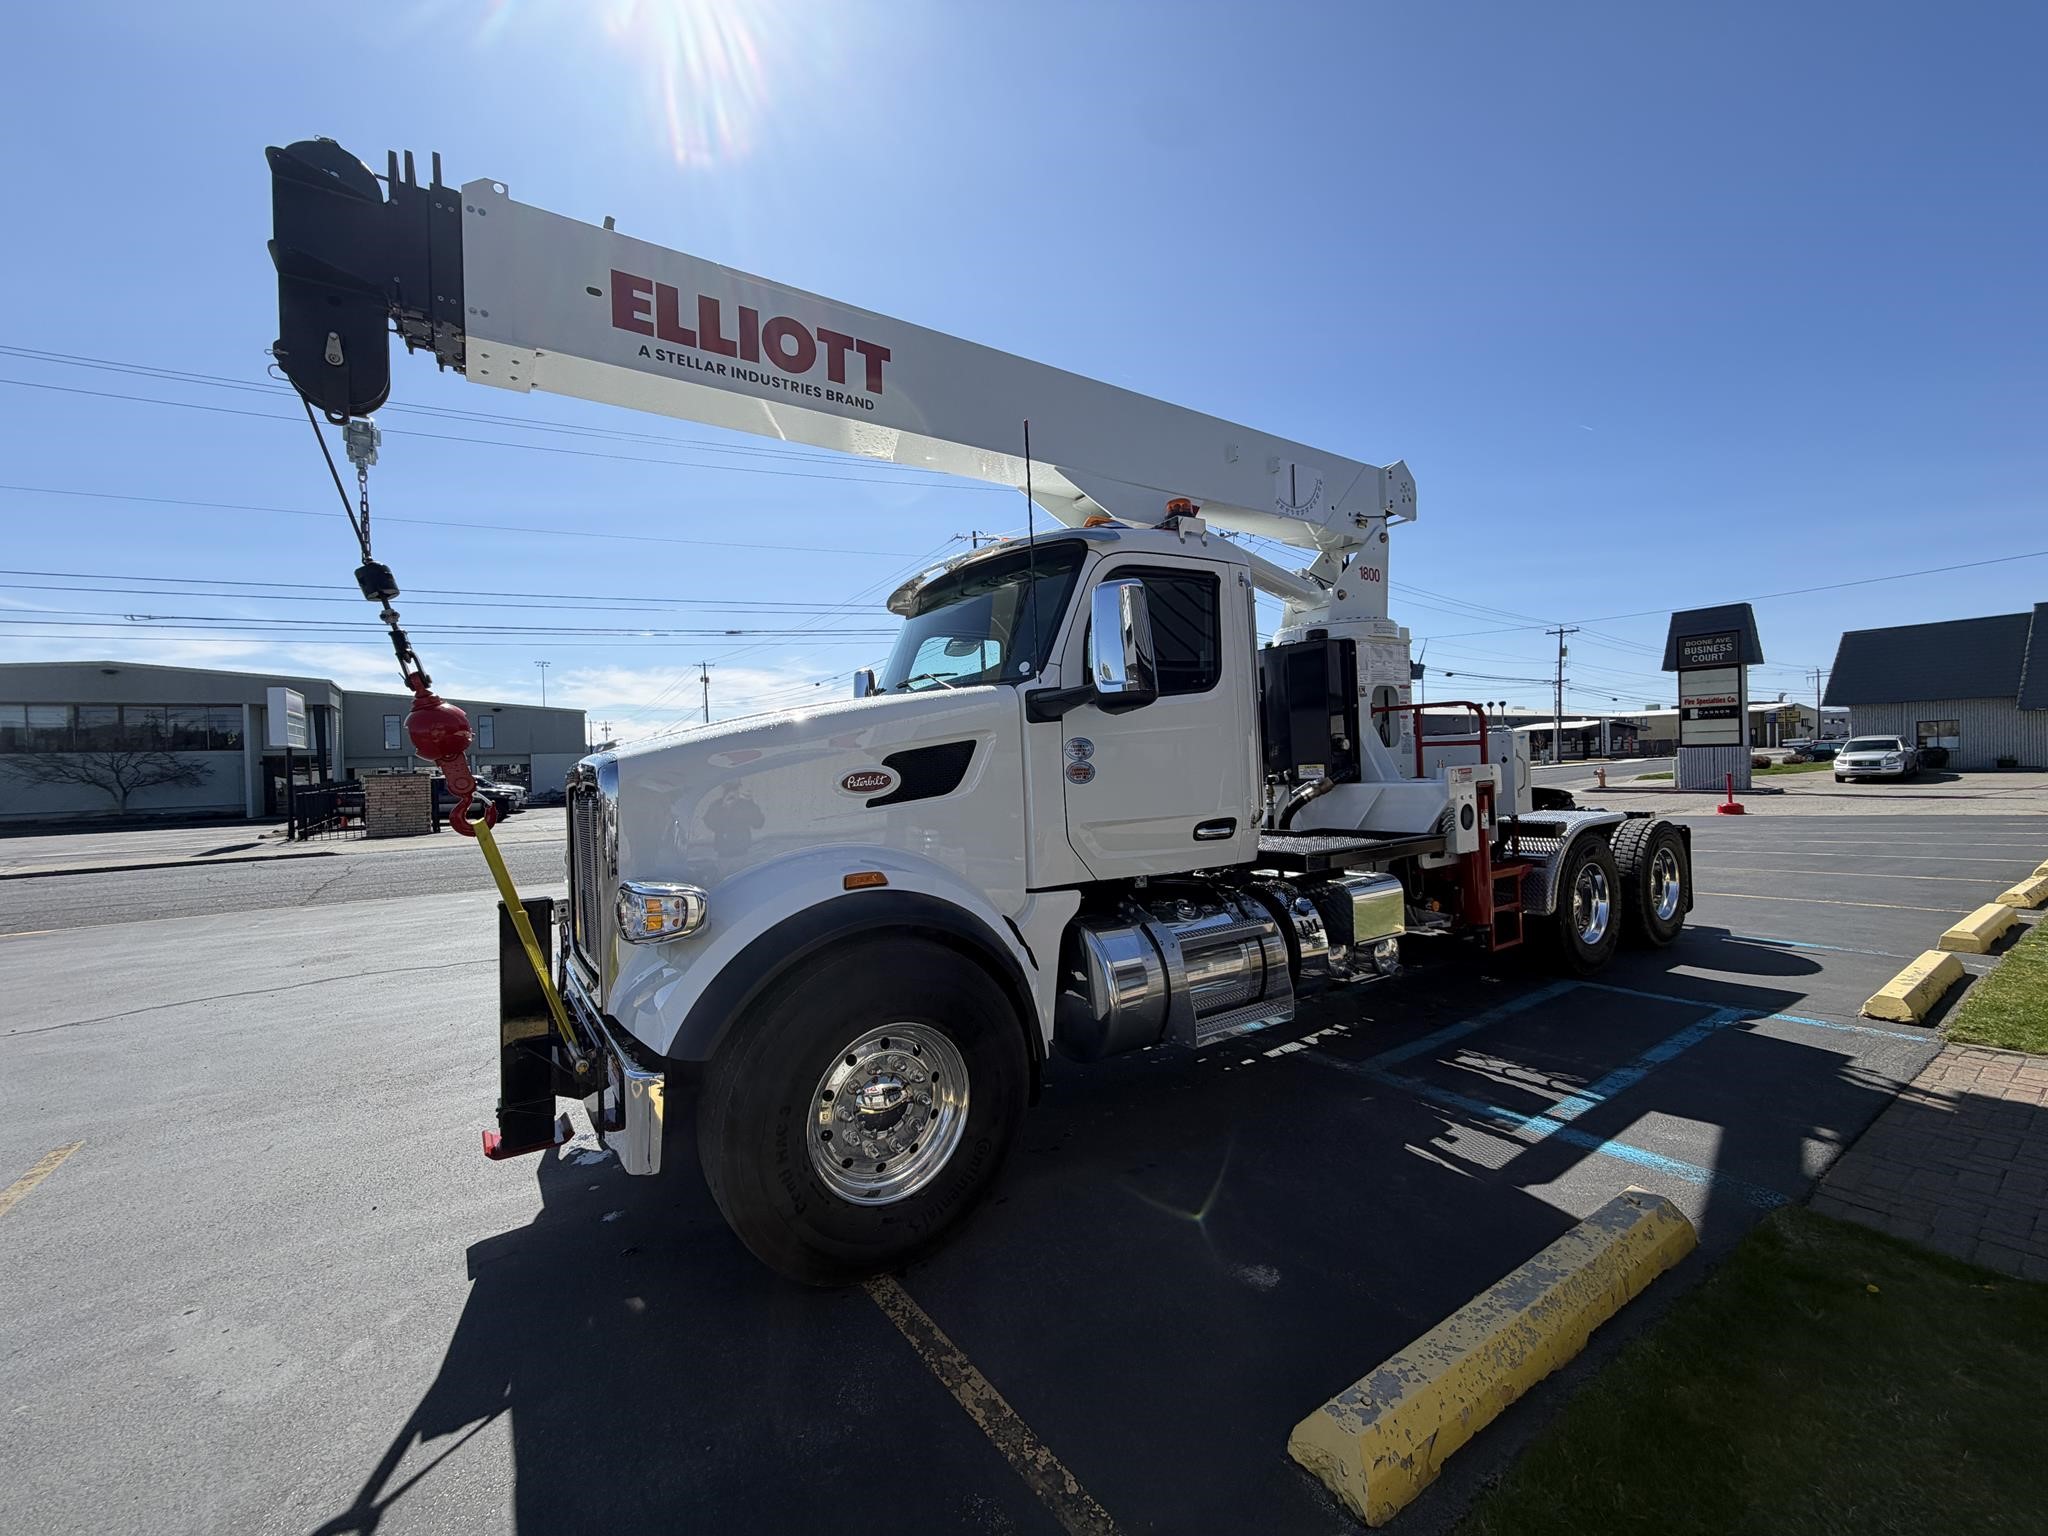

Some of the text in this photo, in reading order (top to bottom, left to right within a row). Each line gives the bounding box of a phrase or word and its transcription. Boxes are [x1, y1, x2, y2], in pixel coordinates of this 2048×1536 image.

[610, 268, 891, 395] ELLIOTT
[638, 344, 875, 411] A STELLAR INDUSTRIES BRAND
[1358, 566, 1381, 583] 1800
[1684, 643, 1733, 655] BUSINESS
[1685, 638, 1713, 647] BOONE
[1691, 653, 1724, 663] COURT
[847, 775, 888, 789] Peterbilt
